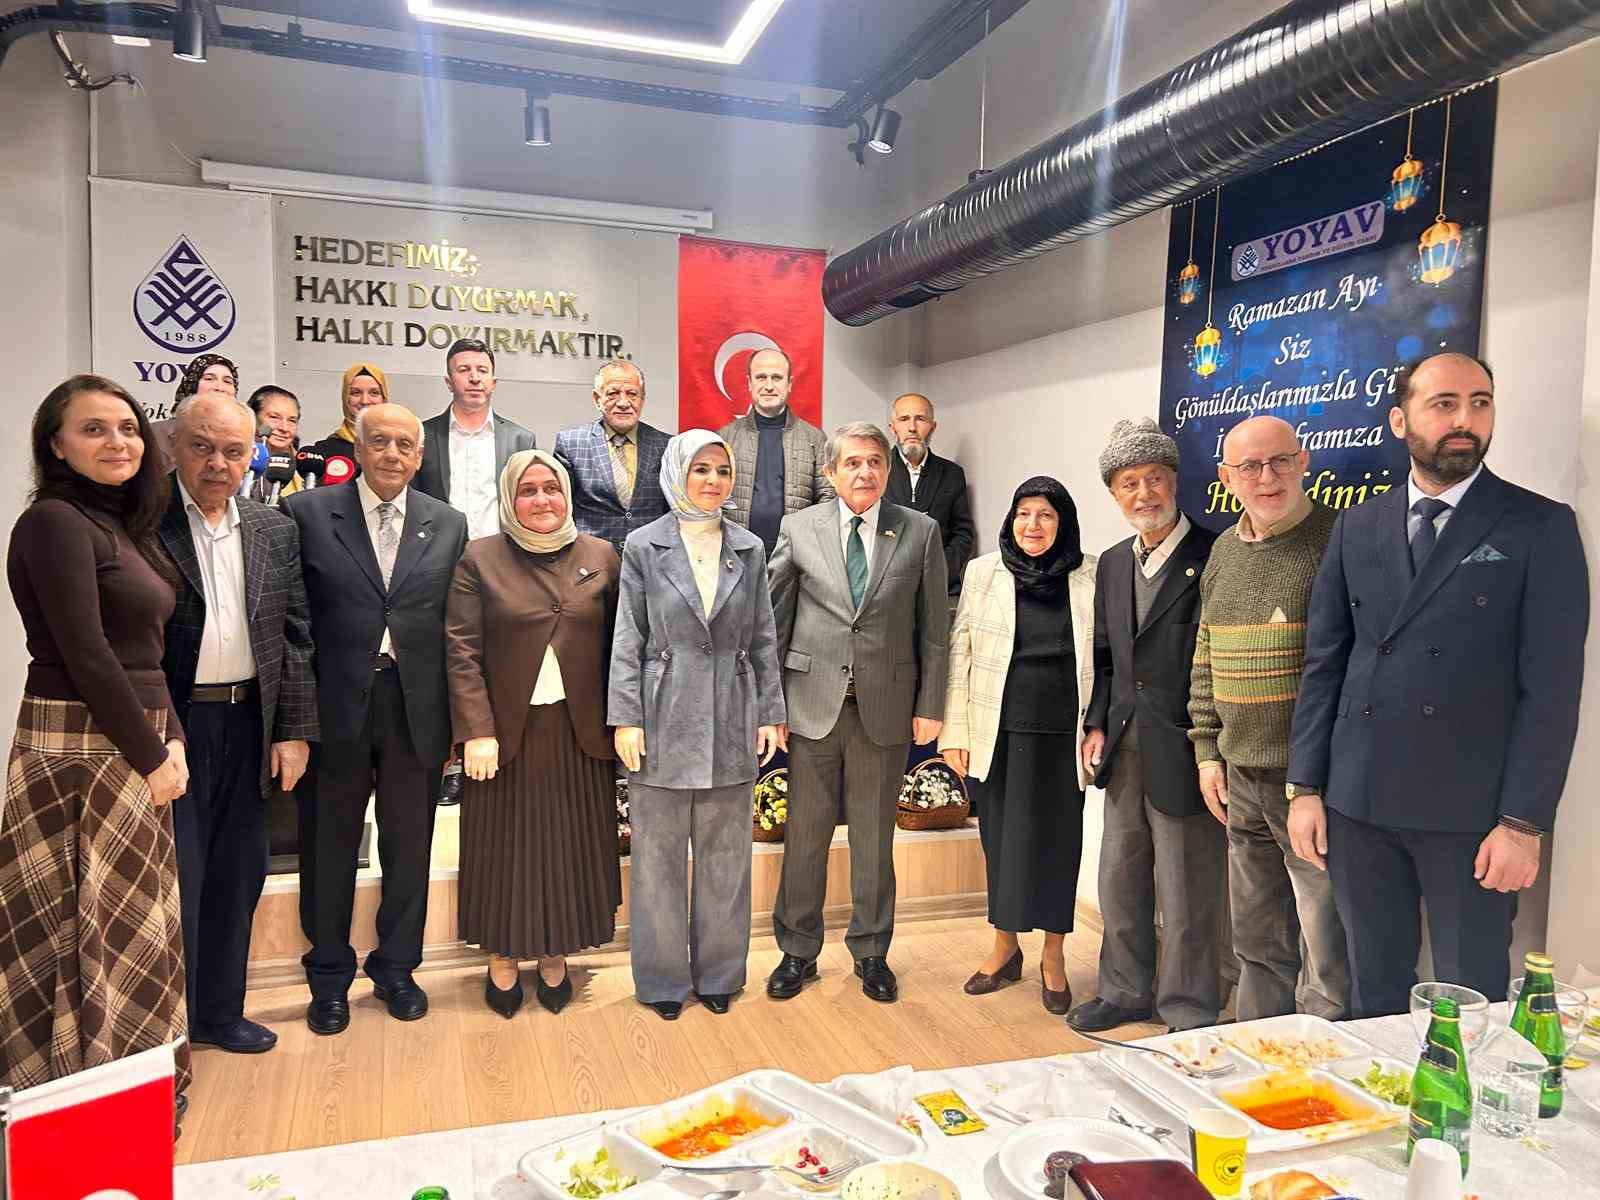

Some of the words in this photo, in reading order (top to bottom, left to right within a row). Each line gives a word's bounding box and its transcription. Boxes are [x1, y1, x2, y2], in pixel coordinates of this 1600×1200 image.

[1263, 203, 1381, 261] YOYAV
[295, 275, 398, 307] HAKKI
[407, 282, 592, 322] DUYURMAK,
[1228, 288, 1327, 330] Ramazan
[1328, 273, 1378, 311] Ayı
[165, 331, 207, 342] 1988
[296, 316, 394, 346] HALKI
[1275, 333, 1312, 365] Siz
[1175, 369, 1356, 429] Gönüldaşlarımızla
